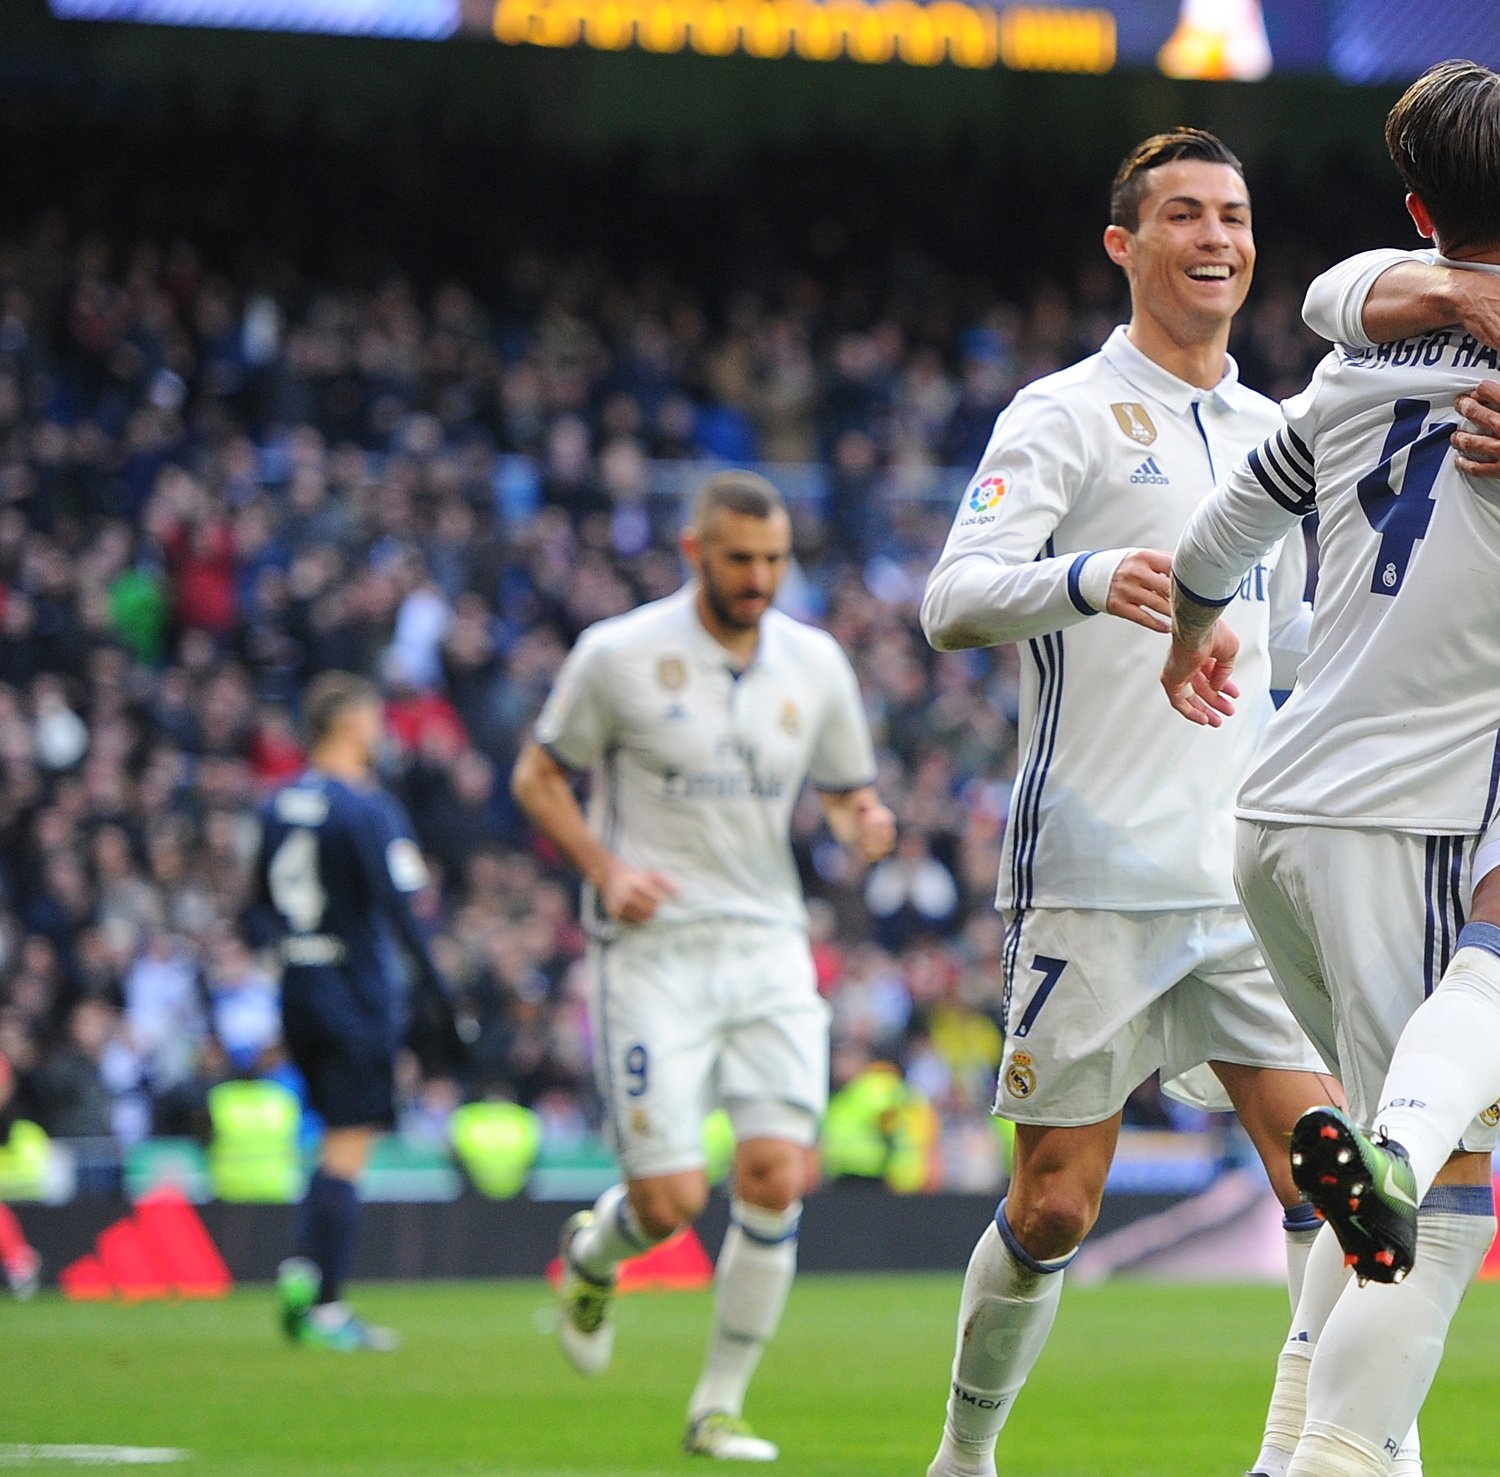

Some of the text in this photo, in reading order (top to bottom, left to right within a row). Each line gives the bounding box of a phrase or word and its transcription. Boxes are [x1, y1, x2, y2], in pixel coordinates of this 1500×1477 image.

[1130, 472, 1170, 485] adidas
[1357, 398, 1458, 597] 4
[269, 827, 328, 933] 4
[1013, 954, 1069, 1038] 7
[625, 1044, 649, 1098] 9
